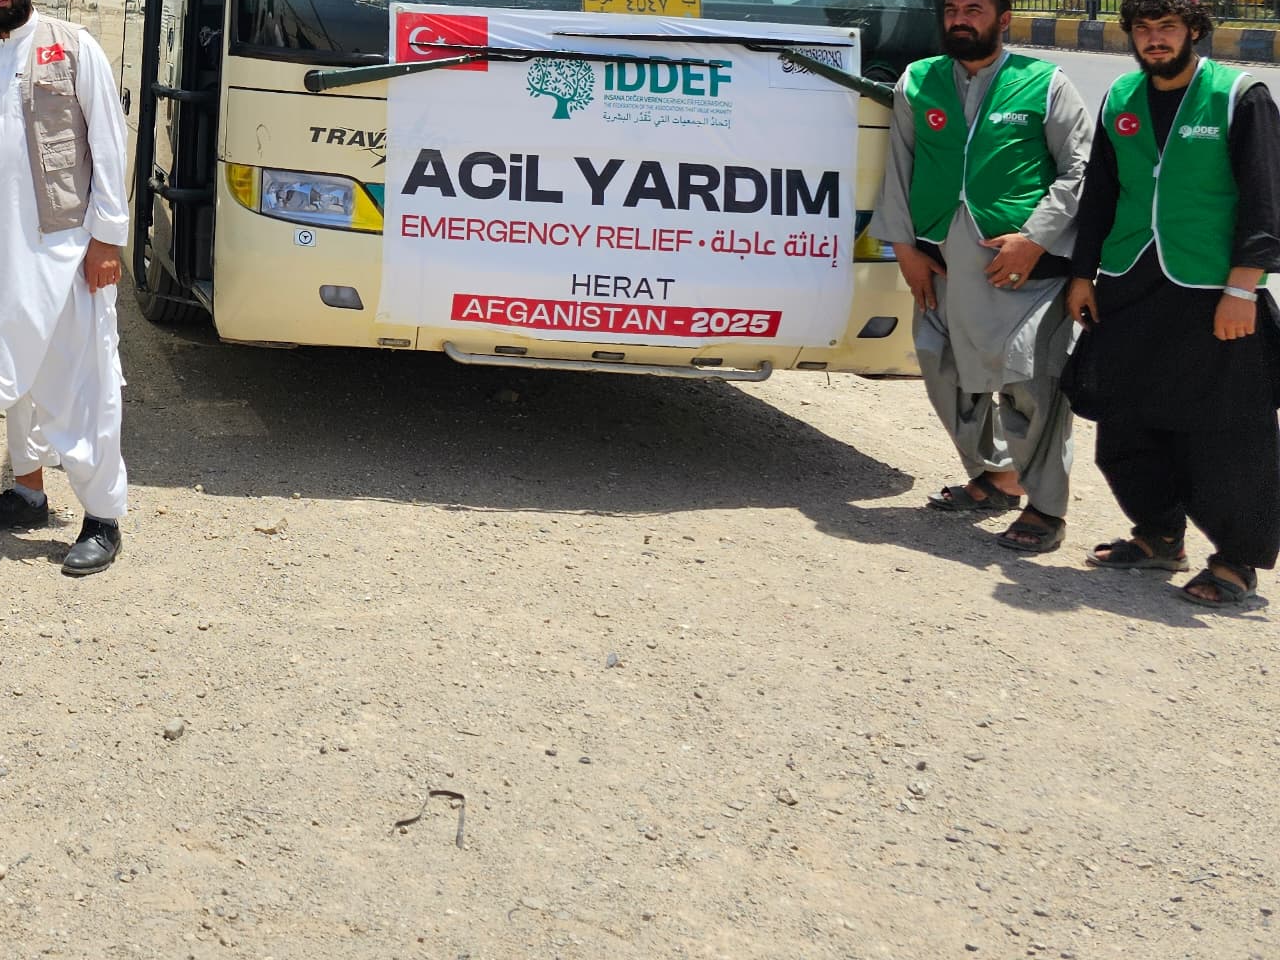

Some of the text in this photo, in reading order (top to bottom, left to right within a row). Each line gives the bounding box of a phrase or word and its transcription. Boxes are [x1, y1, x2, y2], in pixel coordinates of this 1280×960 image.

[309, 126, 387, 148] TRAV
[573, 156, 840, 219] YARDIM
[401, 214, 693, 253] EMERGENCY RELIEF
[711, 228, 839, 269] إغاثة عاجلة
[571, 274, 676, 300] HERAT
[690, 311, 771, 334] 2025
